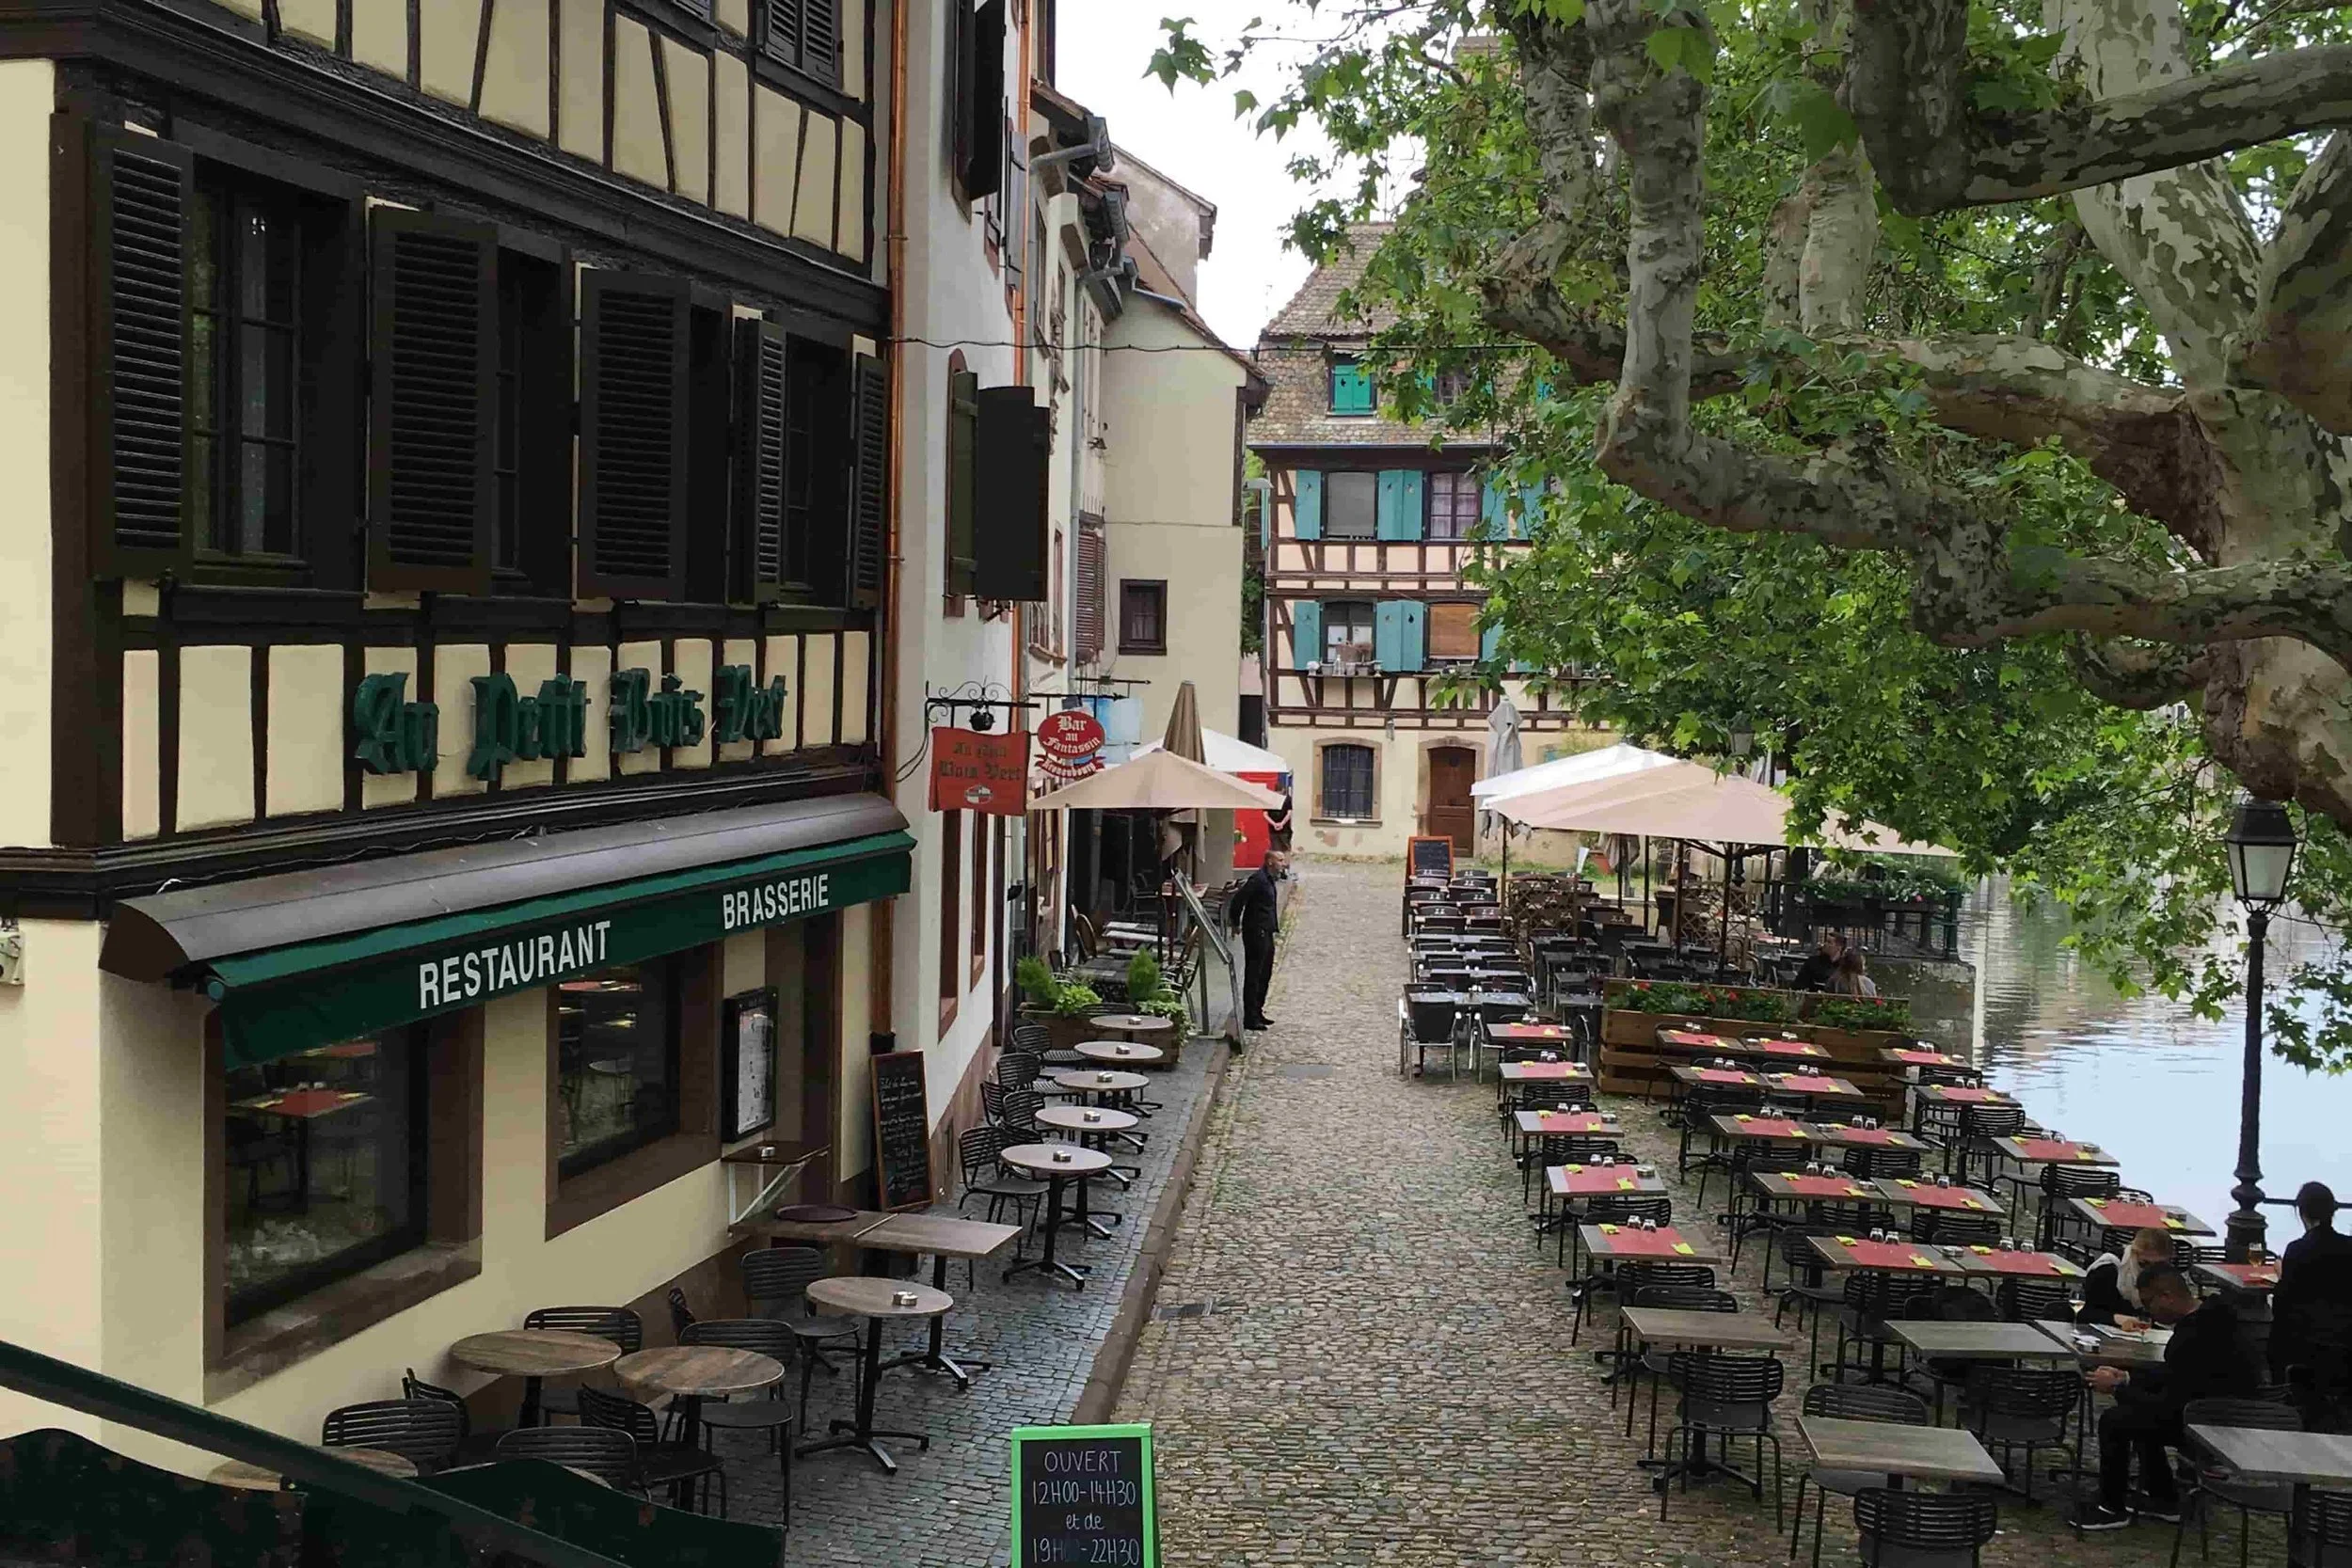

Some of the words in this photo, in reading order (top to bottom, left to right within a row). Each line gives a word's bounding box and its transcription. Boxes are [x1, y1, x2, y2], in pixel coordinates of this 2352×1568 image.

[354, 672, 438, 774] Au
[610, 667, 705, 753] Bois
[1057, 716, 1087, 733] Bar
[1043, 736, 1101, 753] Fantassin
[1065, 733, 1078, 741] au
[723, 874, 829, 929] BRASSERIE
[419, 921, 611, 1009] RESTAURANT
[1044, 1449, 1121, 1473] OUVERT
[1066, 1513, 1080, 1529] et
[1084, 1513, 1104, 1529] de
